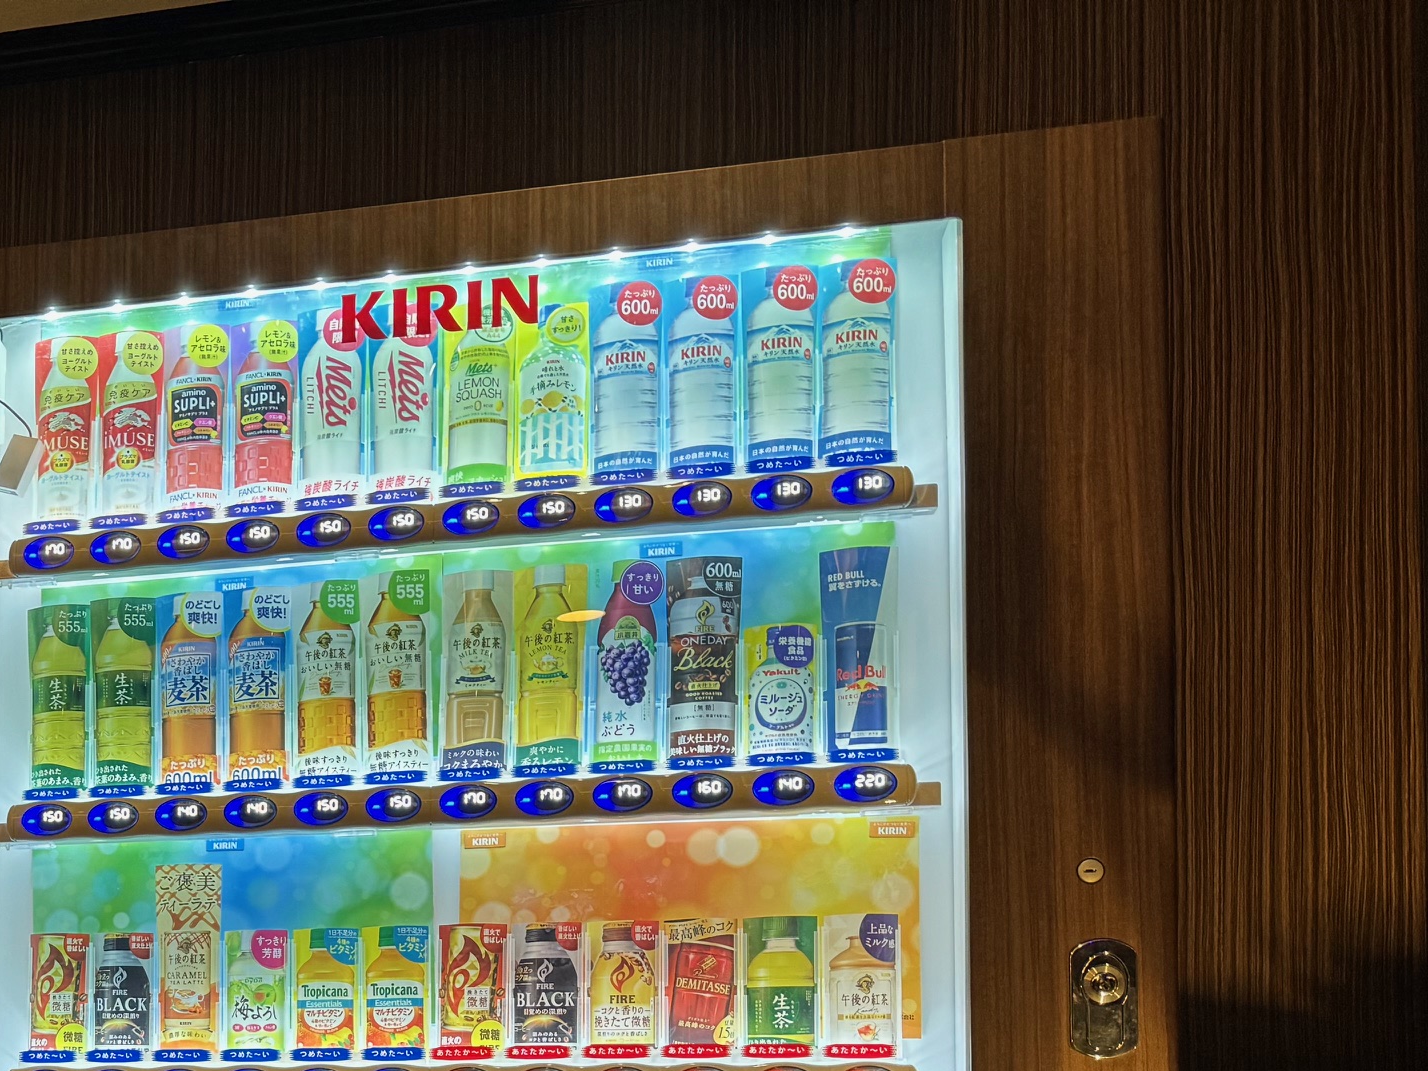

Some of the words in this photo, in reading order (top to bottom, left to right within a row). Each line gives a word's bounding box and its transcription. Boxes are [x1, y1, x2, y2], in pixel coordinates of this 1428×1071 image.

[856, 266, 889, 276] たっぷり
[852, 277, 892, 293] 600ml
[624, 289, 655, 298] たっぷり
[341, 274, 539, 343] KIRIN
[835, 329, 878, 344] KIRIN
[127, 341, 159, 351] 甘さ控えめ
[191, 343, 226, 353] アセロラ味
[761, 337, 802, 351] KIRIN
[128, 352, 158, 361] ヨーグルト
[605, 351, 646, 364] KIRIN
[131, 360, 155, 368] テイスト
[252, 384, 277, 392] amino
[398, 350, 429, 423] Mets
[457, 376, 500, 391] LEMON
[325, 355, 357, 428] Mets
[456, 388, 502, 404] SQUASH
[243, 391, 286, 407] SUPLI+
[825, 436, 884, 449] 日本の自然が育んだ
[705, 562, 742, 578] 600ml
[828, 572, 842, 582] RED
[844, 570, 865, 580] BULL
[626, 572, 659, 583] すっきり
[396, 584, 424, 599] 555
[632, 583, 654, 595] 甘い
[714, 580, 734, 592] 無糖
[828, 578, 882, 593] 翼をさずける。
[254, 594, 290, 605] のどごし
[257, 605, 287, 620] 爽快!
[124, 613, 154, 627] 555ml
[694, 624, 715, 632] FIRE
[525, 632, 574, 647] 午後の紅茶
[680, 635, 729, 646] ONEDAY
[170, 655, 204, 667] さわやか
[370, 654, 422, 667] おいしい無糖
[674, 646, 734, 672] Black
[173, 665, 202, 676] 香ばし
[762, 668, 801, 676] Yakult
[836, 664, 863, 681] Red
[115, 672, 133, 705] 生茶
[167, 676, 209, 703] 麦茶
[759, 692, 803, 704] ミルージュ
[602, 709, 627, 722] 純水
[769, 704, 795, 716] ソーダ
[601, 724, 635, 737] ぶどう
[677, 733, 729, 745] 直火仕上げの
[376, 748, 419, 761] 後味すっきり
[447, 748, 499, 759] ミルクの味わい
[159, 871, 217, 892] ご褒美
[160, 897, 217, 912] ティーラテ
[668, 920, 734, 942] 最高峰のコク
[867, 923, 893, 934] 上品な
[256, 936, 287, 947] すっきり
[261, 947, 282, 959] 芳醇
[167, 970, 207, 981] CARAMEL
[370, 983, 418, 998] Tropicana
[676, 977, 731, 995] DEMITASSE
[305, 1000, 342, 1008] Essentials
[517, 992, 575, 1008] BLACK
[609, 994, 636, 1004] FIRE
[841, 993, 889, 1006] 午後の紅茶
[232, 996, 277, 1021] 梅よろし
[304, 1009, 345, 1018] マルチビタミン
[772, 993, 794, 1029] 生茶
[594, 1015, 651, 1029] 挽きたて微糖
[62, 1031, 83, 1042] 微糖
